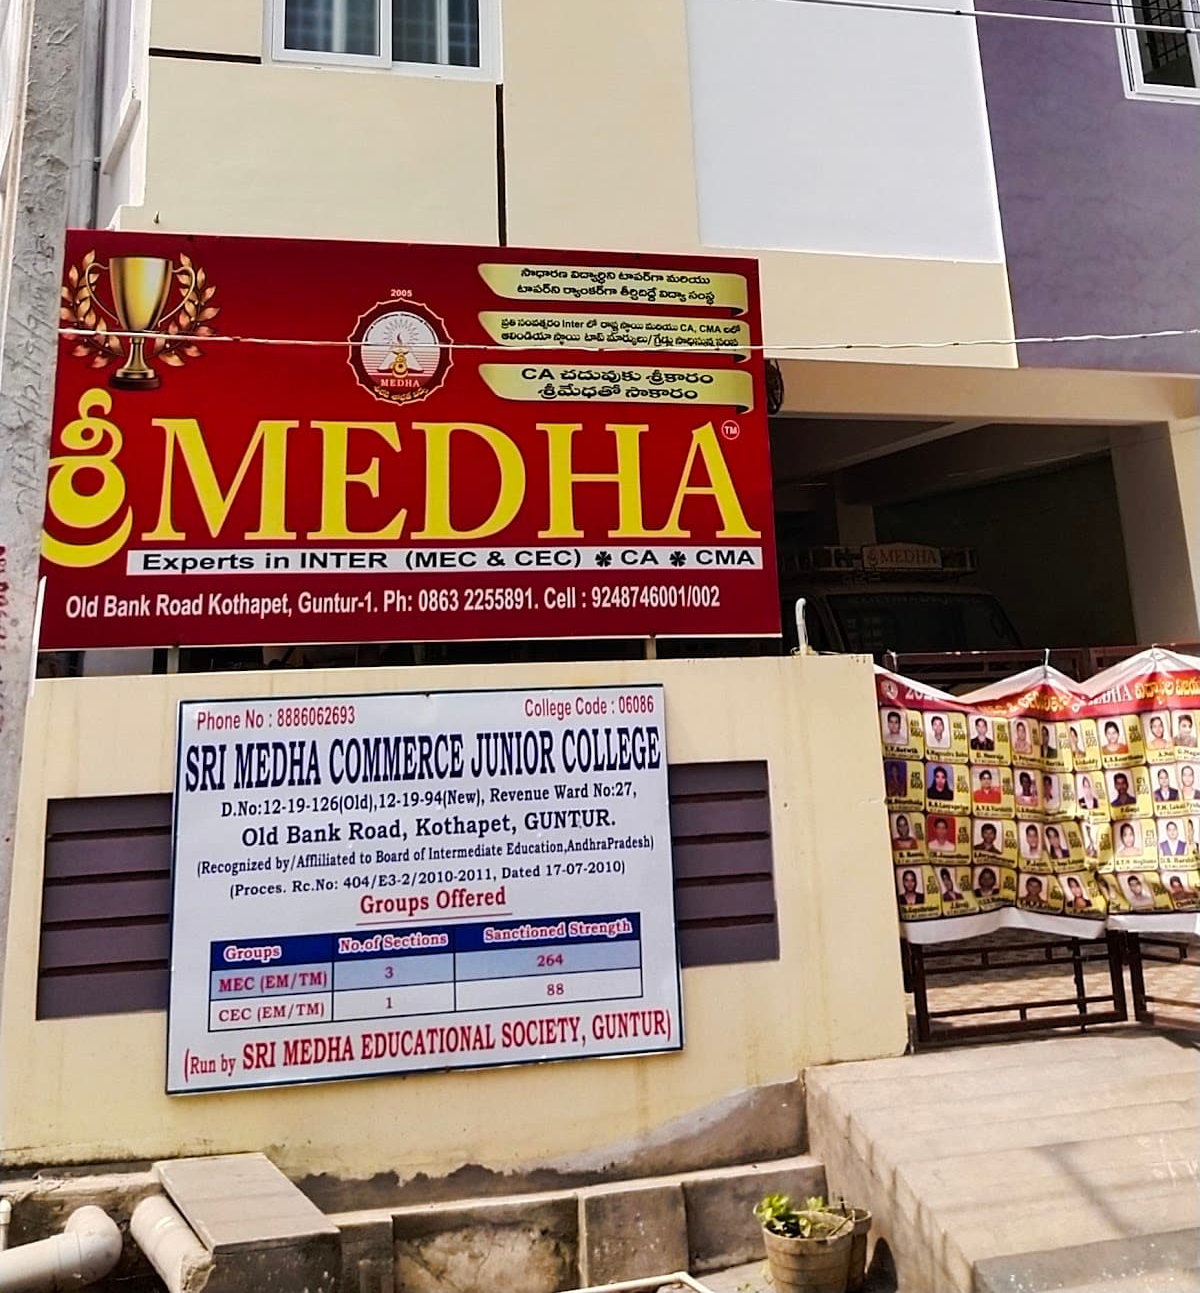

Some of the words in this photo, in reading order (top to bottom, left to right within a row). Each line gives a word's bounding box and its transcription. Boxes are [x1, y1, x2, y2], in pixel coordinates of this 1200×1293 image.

[521, 268, 568, 279] సాధారణ
[667, 275, 710, 285] మరియు
[391, 289, 413, 297] 2005
[562, 320, 584, 328] Inter
[680, 324, 697, 333] CA,
[699, 325, 721, 333] CMA
[380, 379, 420, 387] MEDHA
[521, 368, 555, 380] CA
[560, 369, 641, 383] చదువుకు
[645, 370, 714, 386] శ్రీకారం
[538, 383, 621, 400] శ్రీమేధతో
[625, 386, 698, 400] సాకారం
[141, 418, 761, 541] MEDHA
[143, 554, 255, 573] Experts
[265, 553, 289, 569] in
[300, 553, 388, 569] INTER
[406, 551, 477, 570] (MEC
[486, 551, 506, 567] &
[515, 549, 581, 568] CEC)
[621, 550, 659, 565] CA
[695, 549, 755, 565] CMA
[880, 549, 937, 564] MEDHA
[65, 595, 98, 618] Old
[103, 595, 151, 617] Bank
[156, 594, 203, 617] Road
[208, 592, 293, 619] Kothapet,
[298, 590, 378, 614] Guntur-1.
[384, 589, 413, 612] Ph:
[419, 588, 459, 612] 0863
[464, 587, 539, 611] 2255891.
[544, 586, 576, 609] Cell
[591, 585, 720, 608] 9248746001/002
[197, 710, 241, 731] Phone
[245, 709, 264, 729] No
[277, 706, 356, 728] 8886062693
[524, 698, 572, 721] College
[575, 696, 608, 716] Code
[618, 695, 655, 714] 06086
[185, 744, 226, 791] SRI
[233, 740, 321, 789] MEDHA
[329, 733, 464, 785] COMMERCE
[471, 730, 556, 778] JUNIOR
[562, 726, 661, 773] COLLEGE
[490, 787, 550, 803] Revenue
[554, 784, 589, 799] Ward
[593, 782, 637, 799] No:27,
[242, 825, 279, 847] Old
[286, 822, 341, 844] Bank
[349, 819, 408, 842] Road,
[415, 813, 517, 838] Kothapet,
[524, 808, 617, 830] GUNTUR.
[197, 857, 272, 877] (Recognized
[359, 851, 372, 865] to
[376, 848, 410, 864] Board
[413, 847, 426, 861] of
[428, 842, 503, 860] Intermediate
[230, 884, 287, 900] (Proces.
[292, 878, 339, 893] Rc.No:
[502, 865, 540, 880] Dated
[546, 859, 625, 877] 17-07-2010)
[360, 894, 430, 917] Groups
[436, 886, 506, 909] Offered
[224, 945, 282, 964] Groups
[383, 929, 448, 950] Sections
[484, 921, 566, 943] Sanctioned
[568, 917, 632, 938] Strength
[218, 976, 255, 993] MEC
[260, 971, 328, 993] (EM/TM)
[384, 966, 394, 979] 3
[536, 954, 564, 968] 264
[218, 1008, 251, 1023] CEC
[257, 1002, 325, 1023] (EM/TM)
[386, 997, 393, 1009] 1
[546, 984, 565, 996] 88
[184, 1048, 216, 1083] (Run
[220, 1053, 236, 1077] by
[242, 1041, 277, 1070] SRI
[283, 1035, 354, 1067] MEDHA
[361, 1024, 496, 1059] EDUCATIONAL
[502, 1016, 586, 1048] SOCIETY,
[592, 1010, 671, 1042] GUNTUR)
